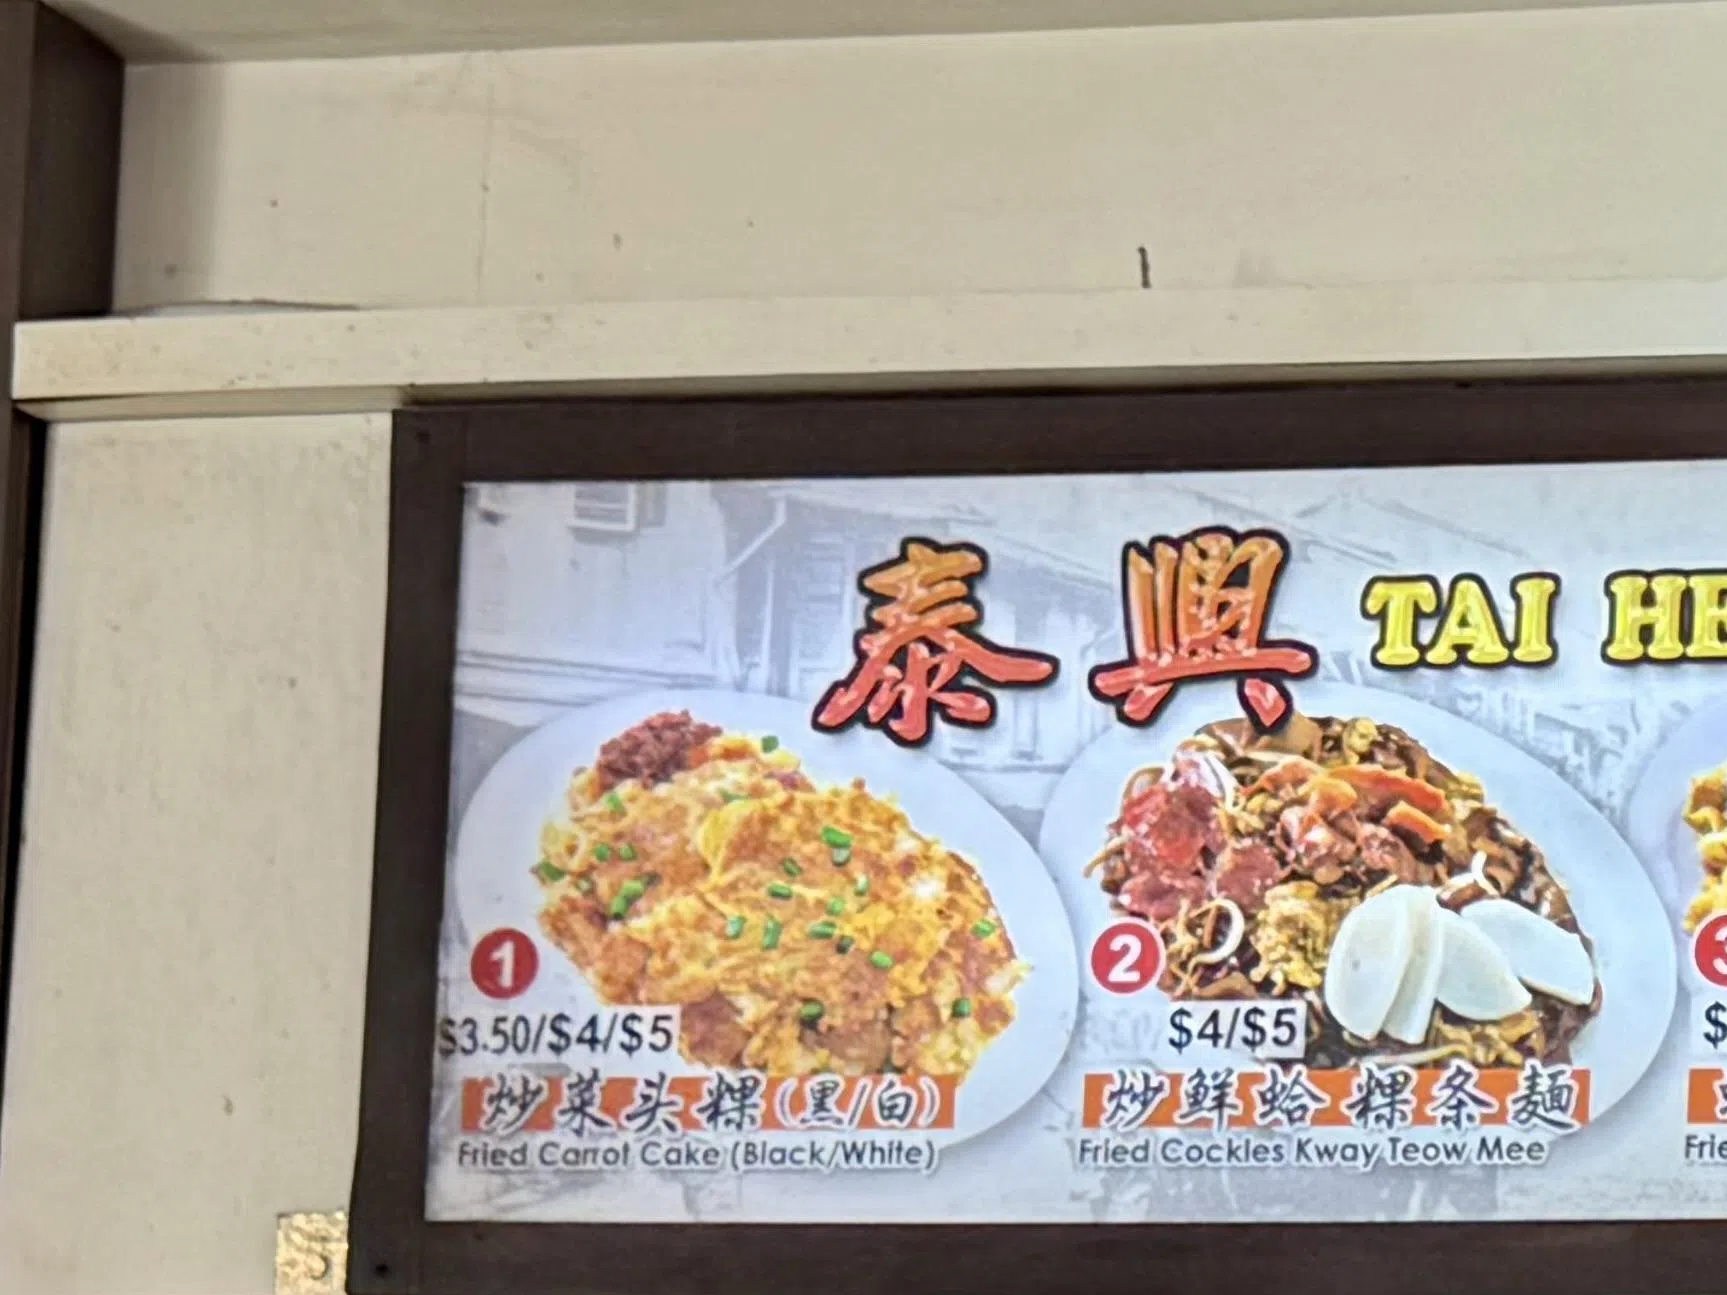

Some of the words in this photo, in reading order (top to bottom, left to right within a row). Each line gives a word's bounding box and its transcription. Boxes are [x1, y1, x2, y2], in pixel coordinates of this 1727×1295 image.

[1362, 573, 1559, 670] TAI
[491, 941, 516, 989] 1
[1110, 936, 1142, 982] 2
[1169, 1007, 1297, 1055] $4/$5
[458, 1141, 528, 1166] Fried
[539, 1141, 629, 1166] Carrot
[643, 1140, 720, 1165] Cake
[731, 1139, 937, 1173] (Black/White)
[1079, 1138, 1149, 1164] Fried
[1161, 1136, 1284, 1163] Cockles
[1298, 1137, 1378, 1169] Kway
[1389, 1138, 1471, 1162] Teow
[1477, 1138, 1545, 1162] Mee
